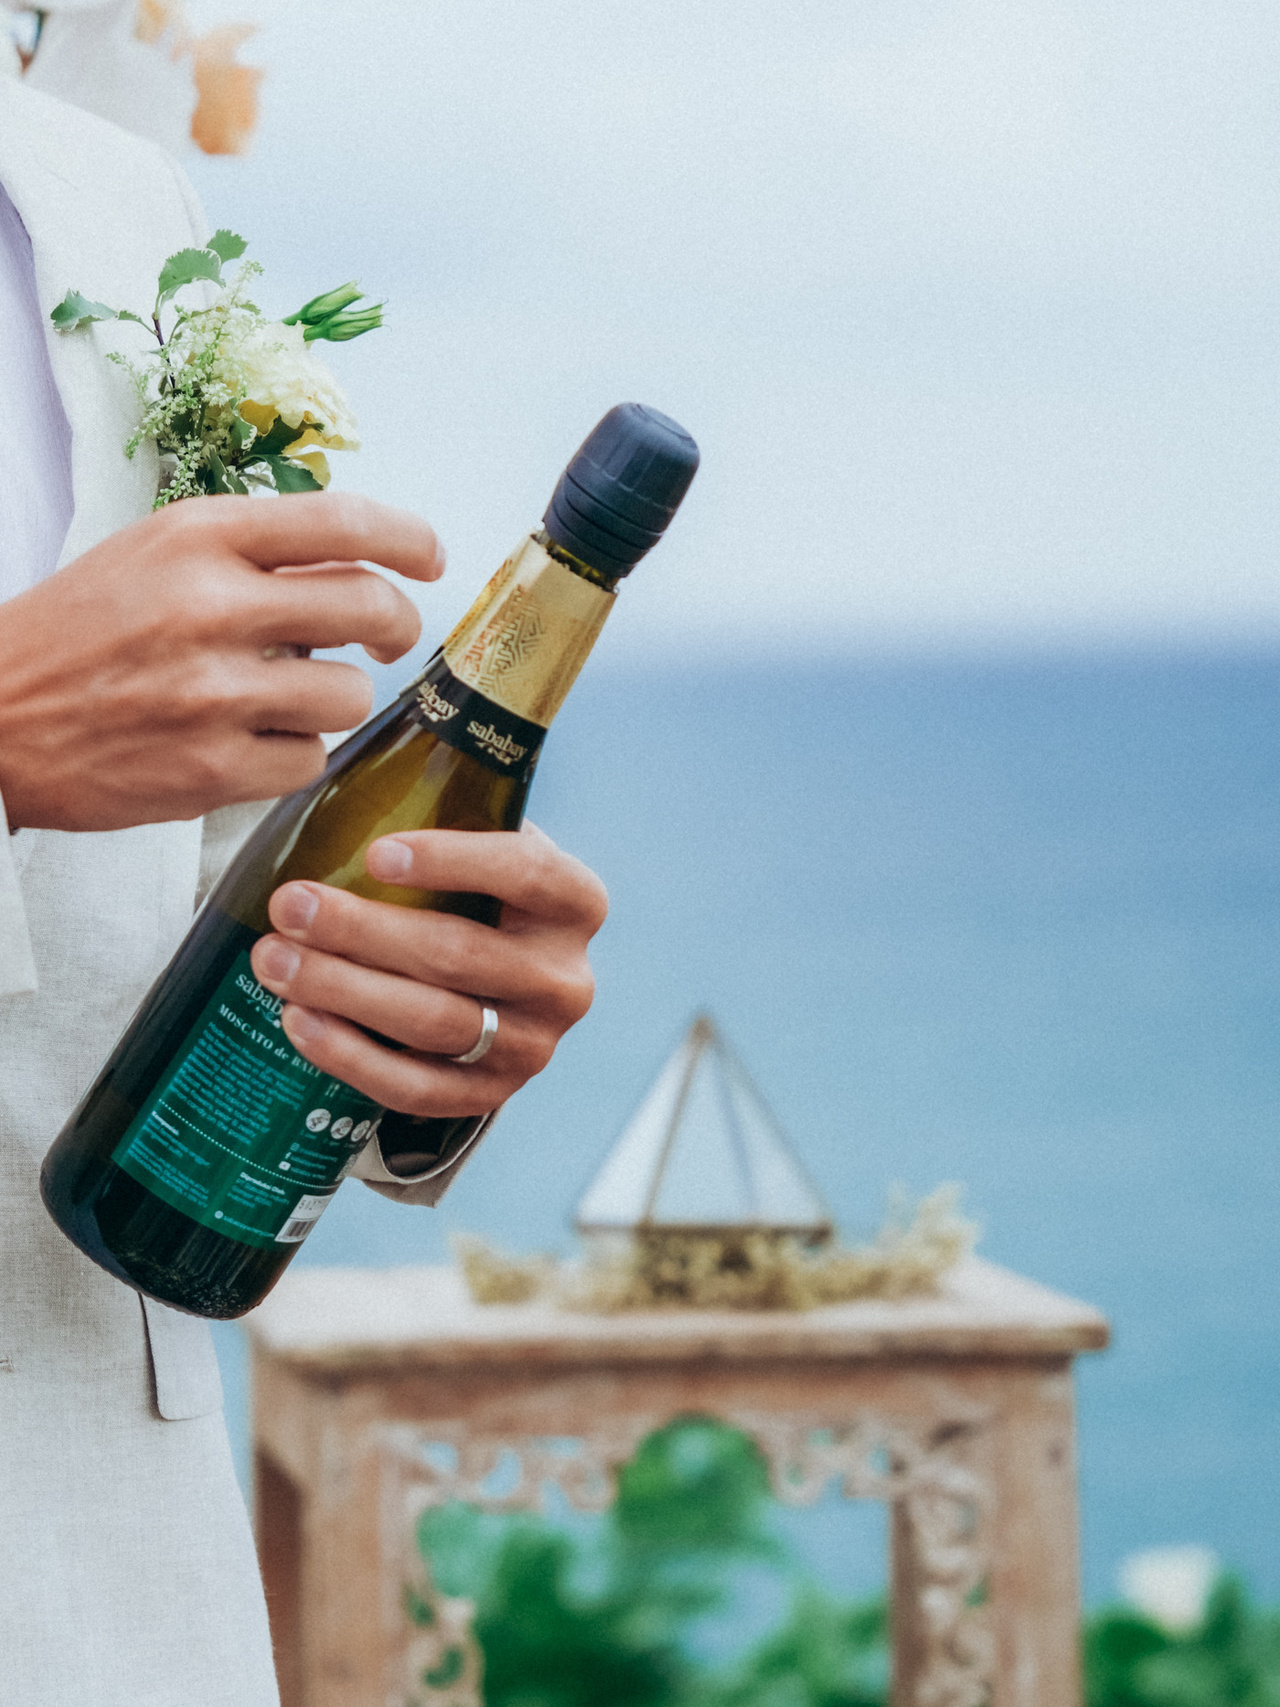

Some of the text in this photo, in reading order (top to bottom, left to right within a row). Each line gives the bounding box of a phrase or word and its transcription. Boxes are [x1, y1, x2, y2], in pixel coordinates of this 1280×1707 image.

[466, 720, 527, 761] sababay
[234, 972, 289, 1017] sabab
[217, 1002, 321, 1078] MOSCATO de BALI
